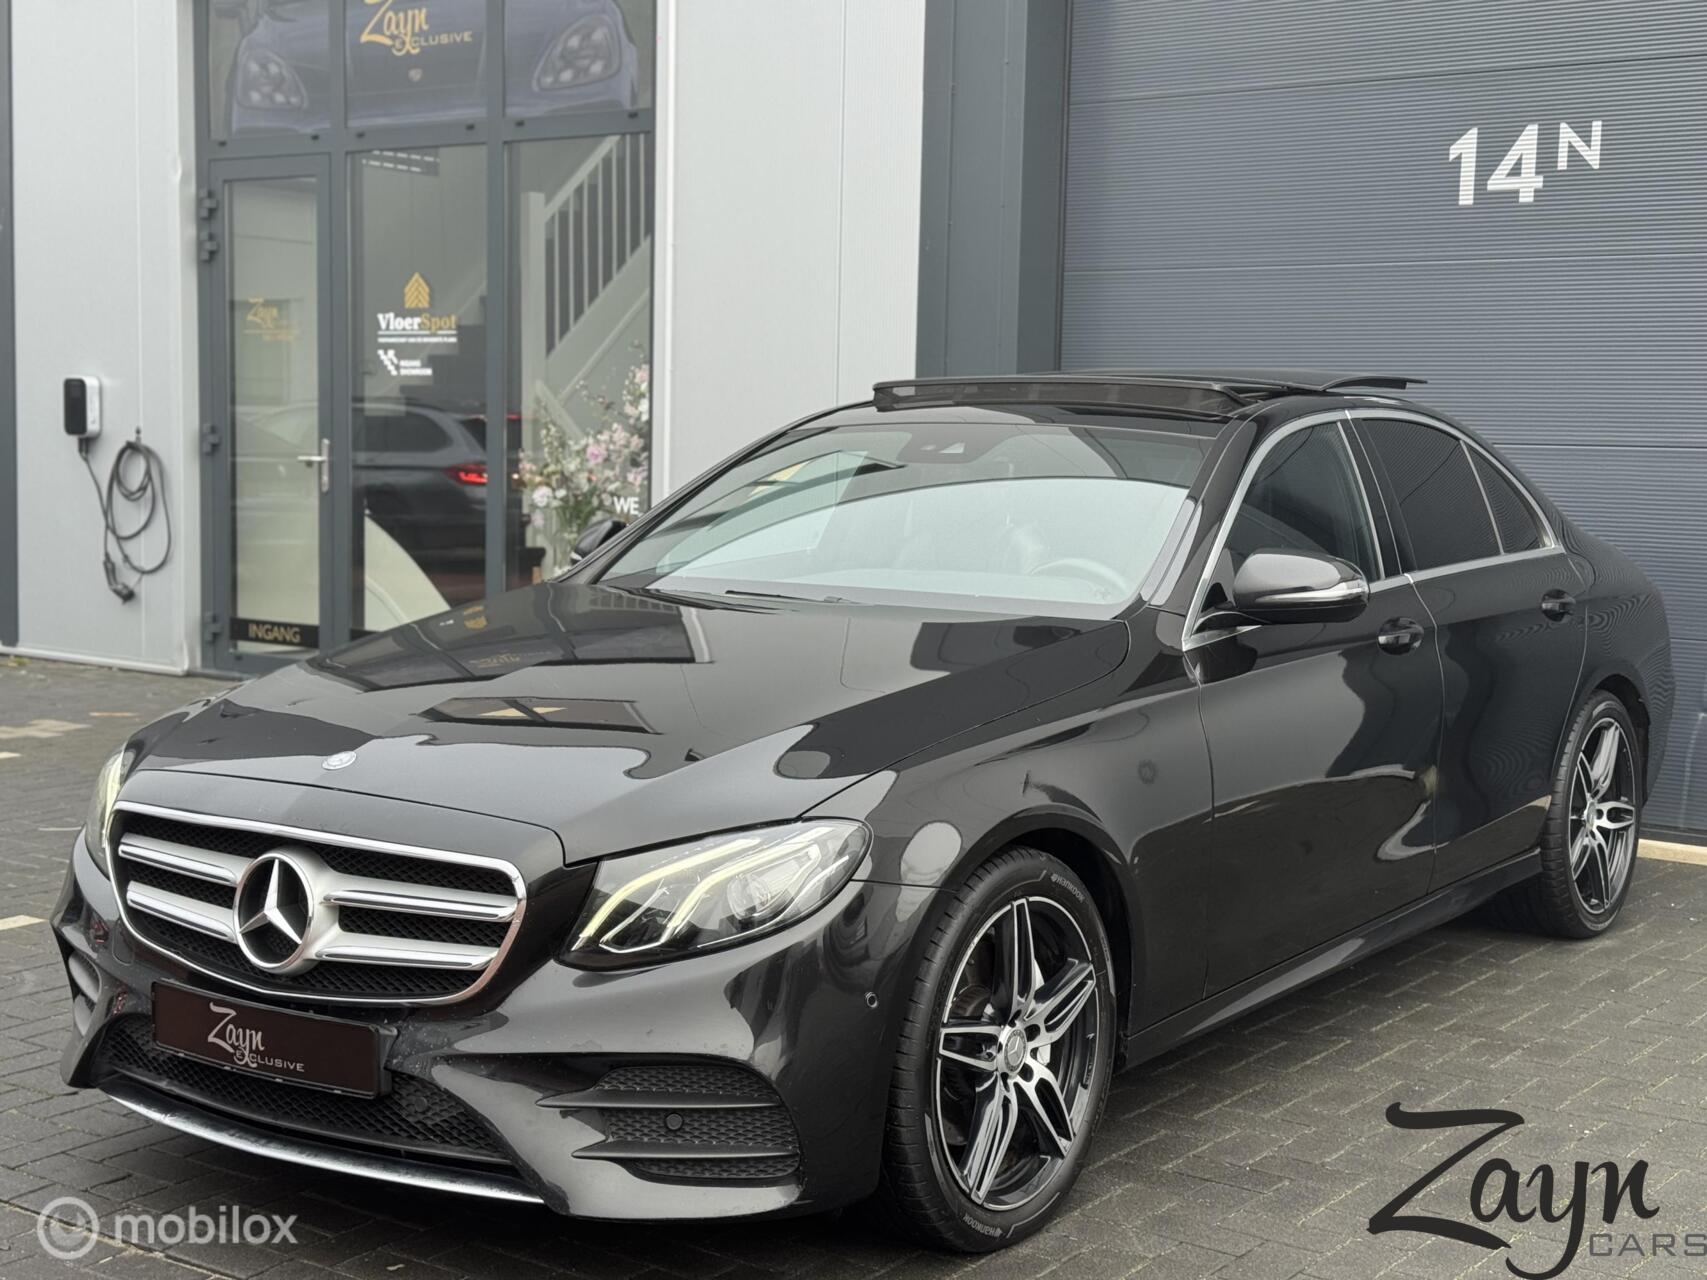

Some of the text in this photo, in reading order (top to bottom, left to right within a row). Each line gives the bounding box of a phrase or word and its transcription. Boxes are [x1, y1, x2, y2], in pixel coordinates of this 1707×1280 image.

[360, 0, 429, 56] Zayn
[377, 312, 457, 333] VloerSpot
[248, 623, 300, 643] INGANG
[207, 1001, 265, 1068] Zayn
[236, 1049, 304, 1072] EXCLUSIVE
